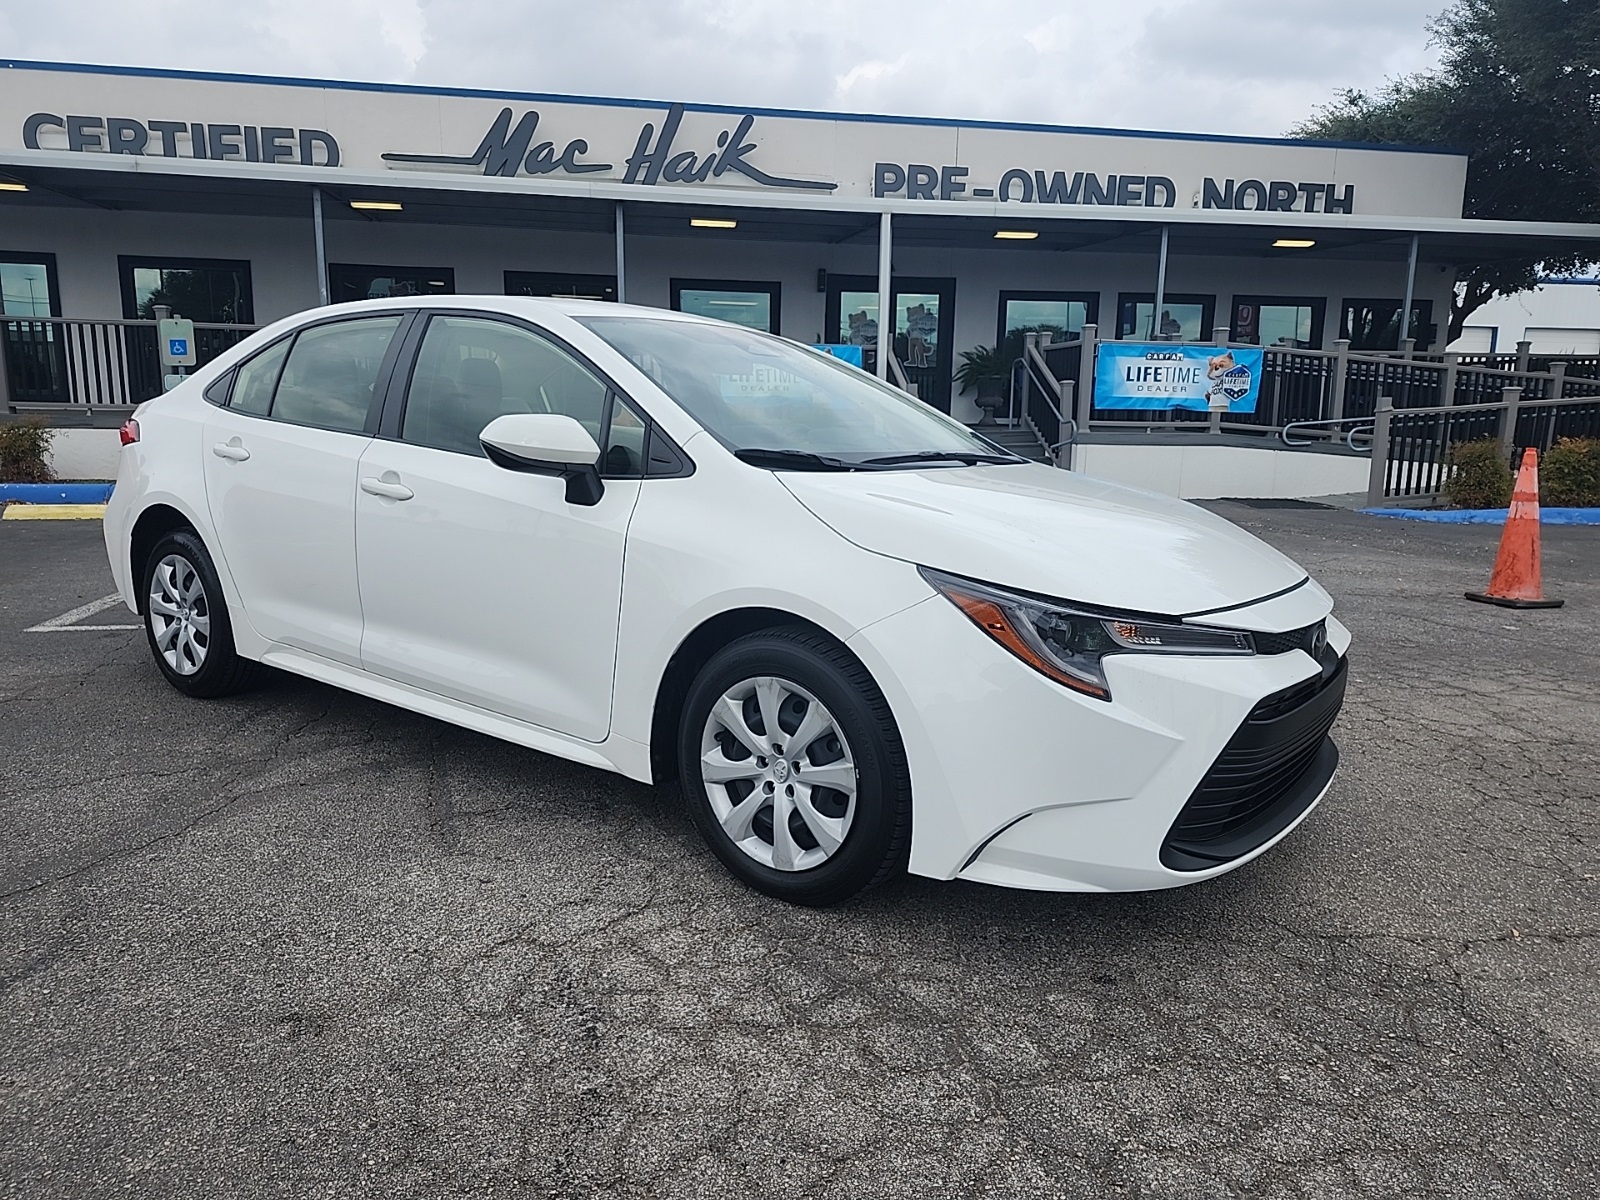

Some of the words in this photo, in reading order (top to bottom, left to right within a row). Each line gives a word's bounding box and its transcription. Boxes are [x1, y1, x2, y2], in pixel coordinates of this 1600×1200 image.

[22, 112, 340, 167] CERTIFIED
[381, 107, 613, 178] Mac
[622, 103, 838, 190] Haik
[874, 162, 1176, 208] PRE-OWNED
[1202, 177, 1355, 214] NORTH
[1145, 353, 1184, 361] CARFAX
[1125, 366, 1201, 384] LIFETIME
[1137, 385, 1187, 393] DEALER
